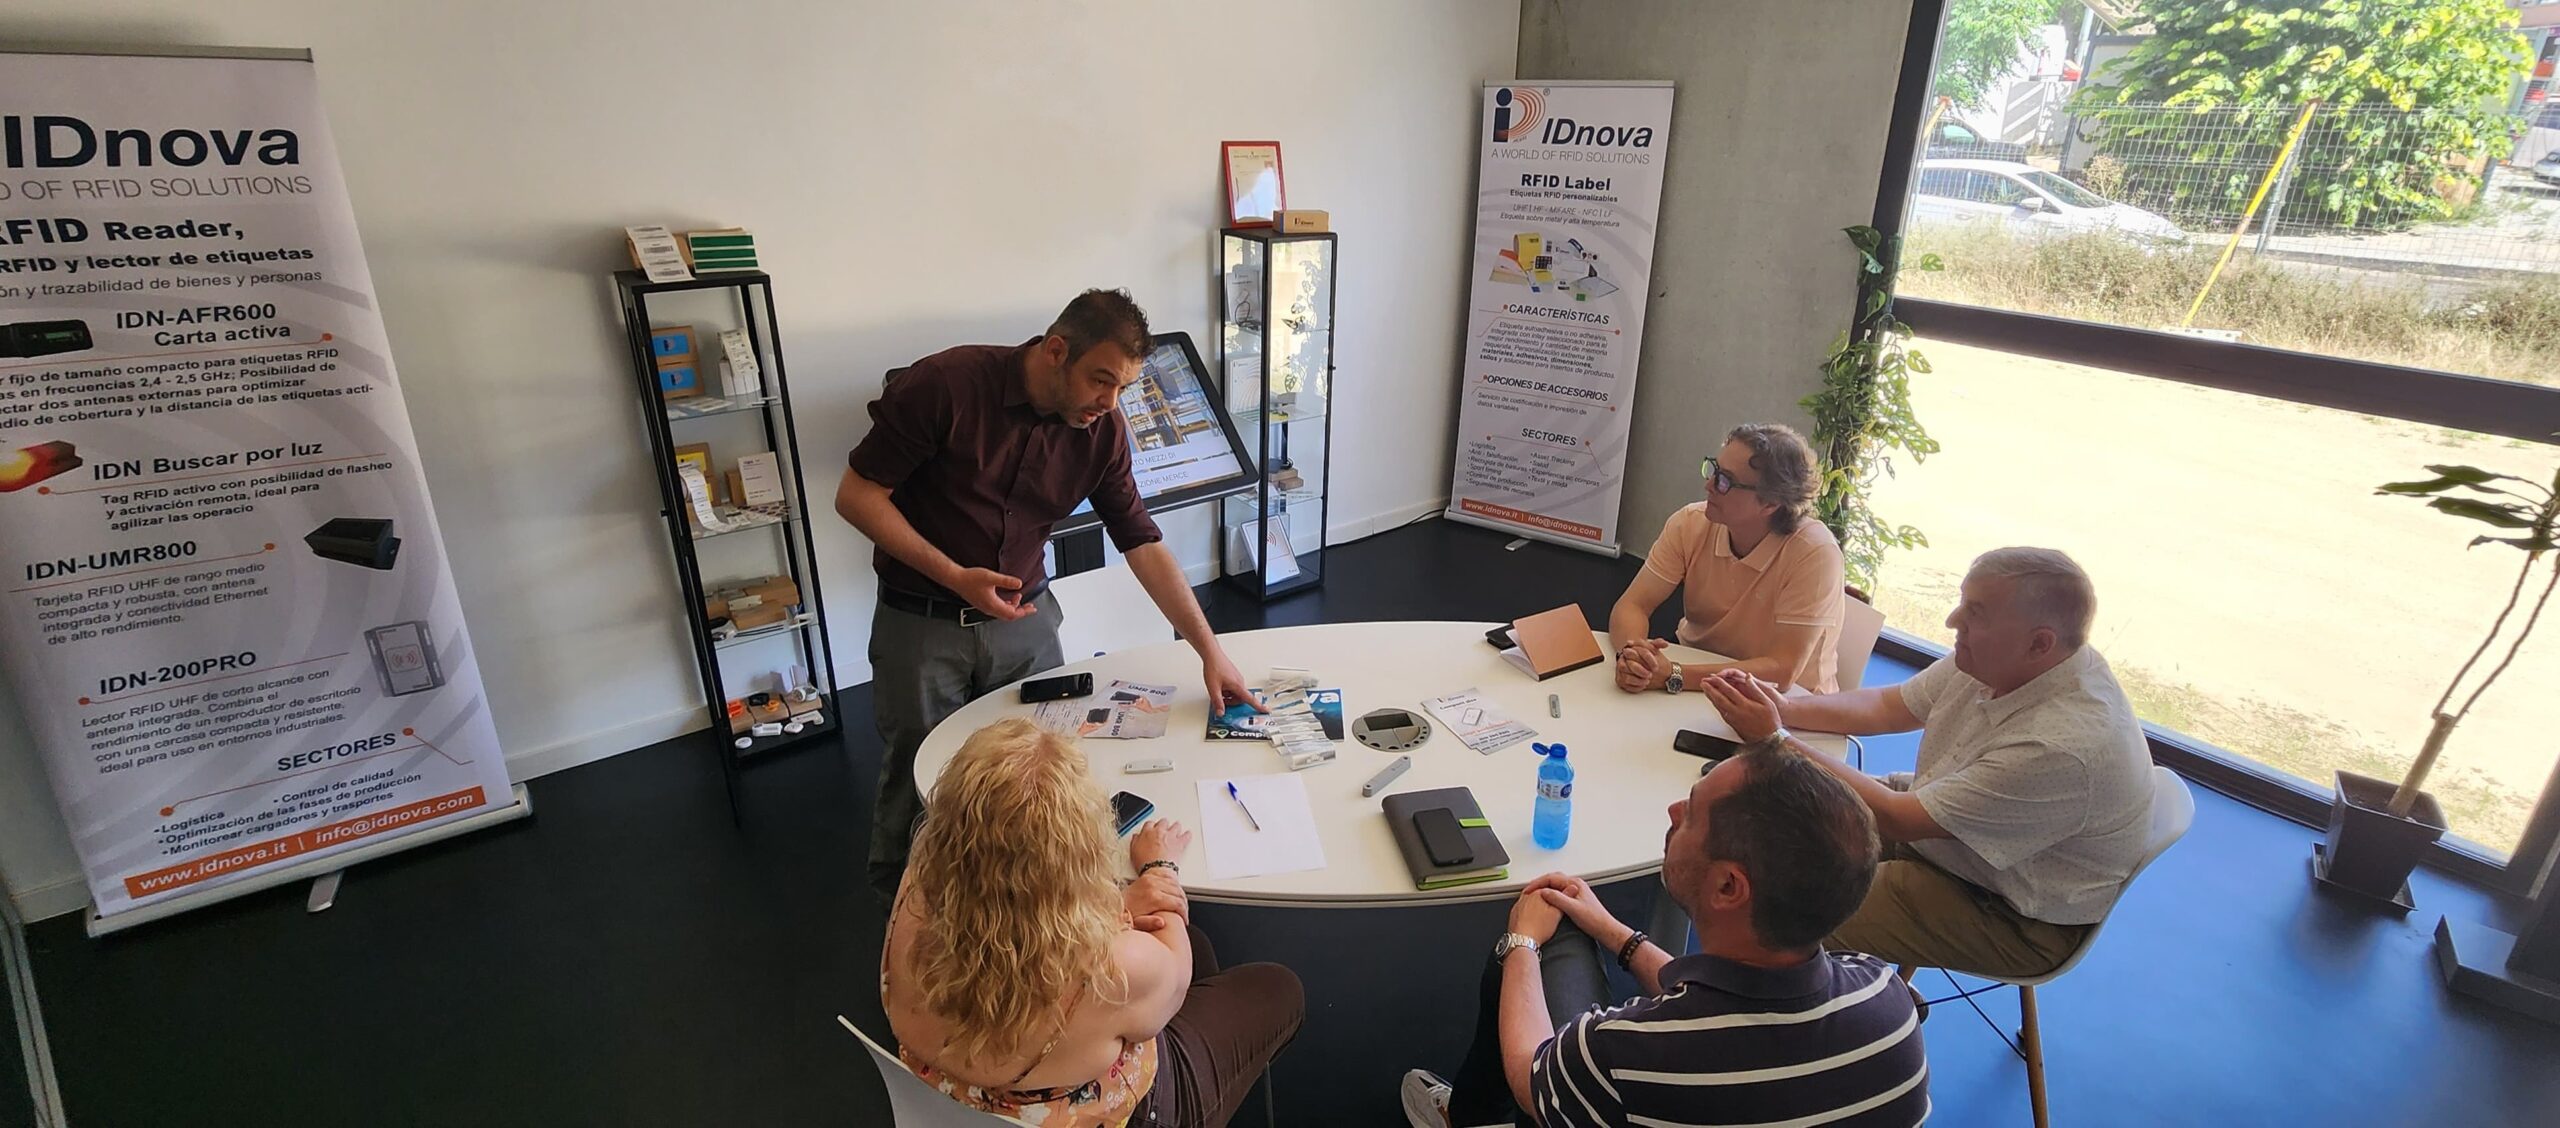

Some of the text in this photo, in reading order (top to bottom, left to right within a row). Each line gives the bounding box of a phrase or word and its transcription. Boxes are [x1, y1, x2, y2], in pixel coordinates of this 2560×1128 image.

[4, 116, 299, 168] IDnova
[1542, 118, 1653, 147] IDnova
[1491, 148, 1650, 165] A WORLD OF RFID SOLUTIONS
[21, 180, 63, 200] OF
[73, 179, 142, 199] RFID
[151, 176, 313, 198] SOLUTIONS
[1510, 190, 1542, 198] Etiquetas
[1562, 193, 1619, 203] personalizables
[1521, 173, 1611, 191] RFID Label
[103, 219, 244, 241] Reader,
[65, 248, 314, 274] y lector de etiquetas
[25, 269, 322, 299] y trazabilidad de bienes y personas
[116, 303, 276, 329] IDN-AFR600
[1509, 303, 1610, 325] CARACTERÍSTICAS
[154, 324, 291, 347] Carta activa
[9, 373, 36, 386] fijo
[41, 371, 61, 381] de
[65, 366, 122, 380] tamaño
[127, 360, 200, 375] compacto
[204, 358, 236, 370] para
[239, 352, 303, 366] etiquetas
[307, 348, 339, 360] RFID
[21, 361, 337, 398] en frecuencias 2,4 2,5 GHz; Posibilidad de
[33, 388, 342, 425] de cobertura la distancia de las etiquetas
[39, 378, 306, 411] dos antenas externas para optimizar
[1487, 374, 1609, 402] OPCIONES DE ACCESORIOS
[1522, 428, 1577, 447] SECTORES
[93, 442, 323, 480] IDN Buscar por luz
[101, 461, 393, 504] Tag RFID activo con posibilidad de flasheo
[120, 482, 320, 516] activación ideal para
[111, 503, 254, 531] agilizar las operacio
[1465, 502, 1598, 537] www.idnova.it info@idnova.com
[26, 541, 197, 581] IDN-UMR800
[34, 563, 266, 607] Tarjeta RFID UHF de rango medio
[38, 578, 255, 620] compacta con antena
[42, 587, 270, 633] integrada conectividad Ethernet
[47, 635, 67, 646] de
[71, 629, 97, 642] alto
[100, 651, 257, 694] IDN-200PRO
[82, 669, 329, 728] Lector RFID UHF de corto alcance con
[86, 722, 134, 739] antena
[207, 694, 264, 713] Combina
[91, 686, 362, 750] rendimiento de un reproductor de escritorio
[95, 717, 270, 762] con una carcasa compacta
[99, 760, 133, 774] ideal
[137, 753, 167, 768] para
[171, 746, 195, 757] uso
[198, 741, 214, 751] en
[218, 728, 272, 748] entornos
[277, 733, 396, 771] SECTORES
[257, 774, 421, 821] de las fases de producción
[281, 769, 394, 803] Control de calidad
[139, 794, 474, 890] www.idnova.it info@idnova.com
[170, 792, 394, 856] Monitorear cargadores trasportes
